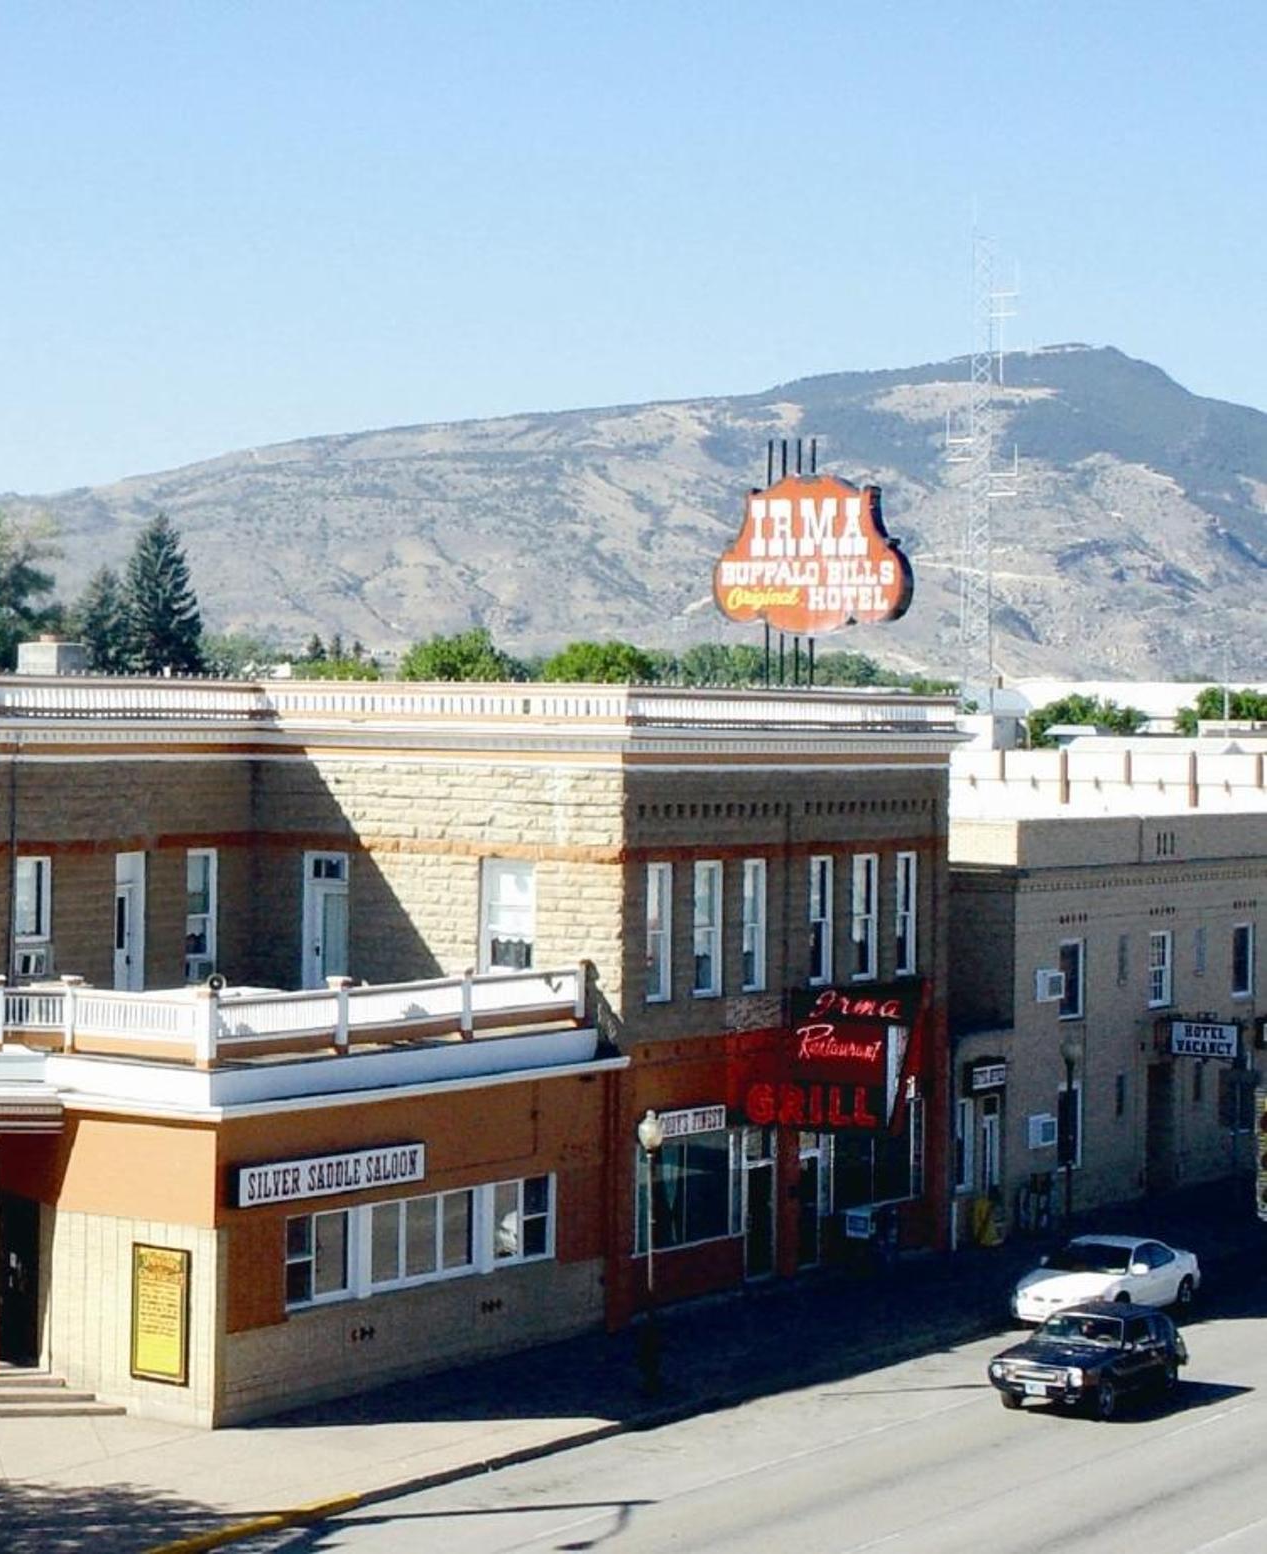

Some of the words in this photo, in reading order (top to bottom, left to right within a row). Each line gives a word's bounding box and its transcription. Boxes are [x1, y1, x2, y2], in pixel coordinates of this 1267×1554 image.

[750, 498, 868, 557] IRMA
[721, 561, 820, 586] BUFFALO
[726, 587, 800, 611] Original
[807, 586, 889, 611] HOTEL
[809, 990, 901, 1019] Irma
[796, 1023, 881, 1062] Restaurant
[1184, 1025, 1227, 1039] HOTEL
[1176, 1040, 1233, 1055] VACANCY
[747, 1084, 877, 1125] GRILL
[247, 1167, 301, 1201] SILVER
[307, 1157, 362, 1191] SADDLE
[366, 1149, 419, 1183] SALOON
